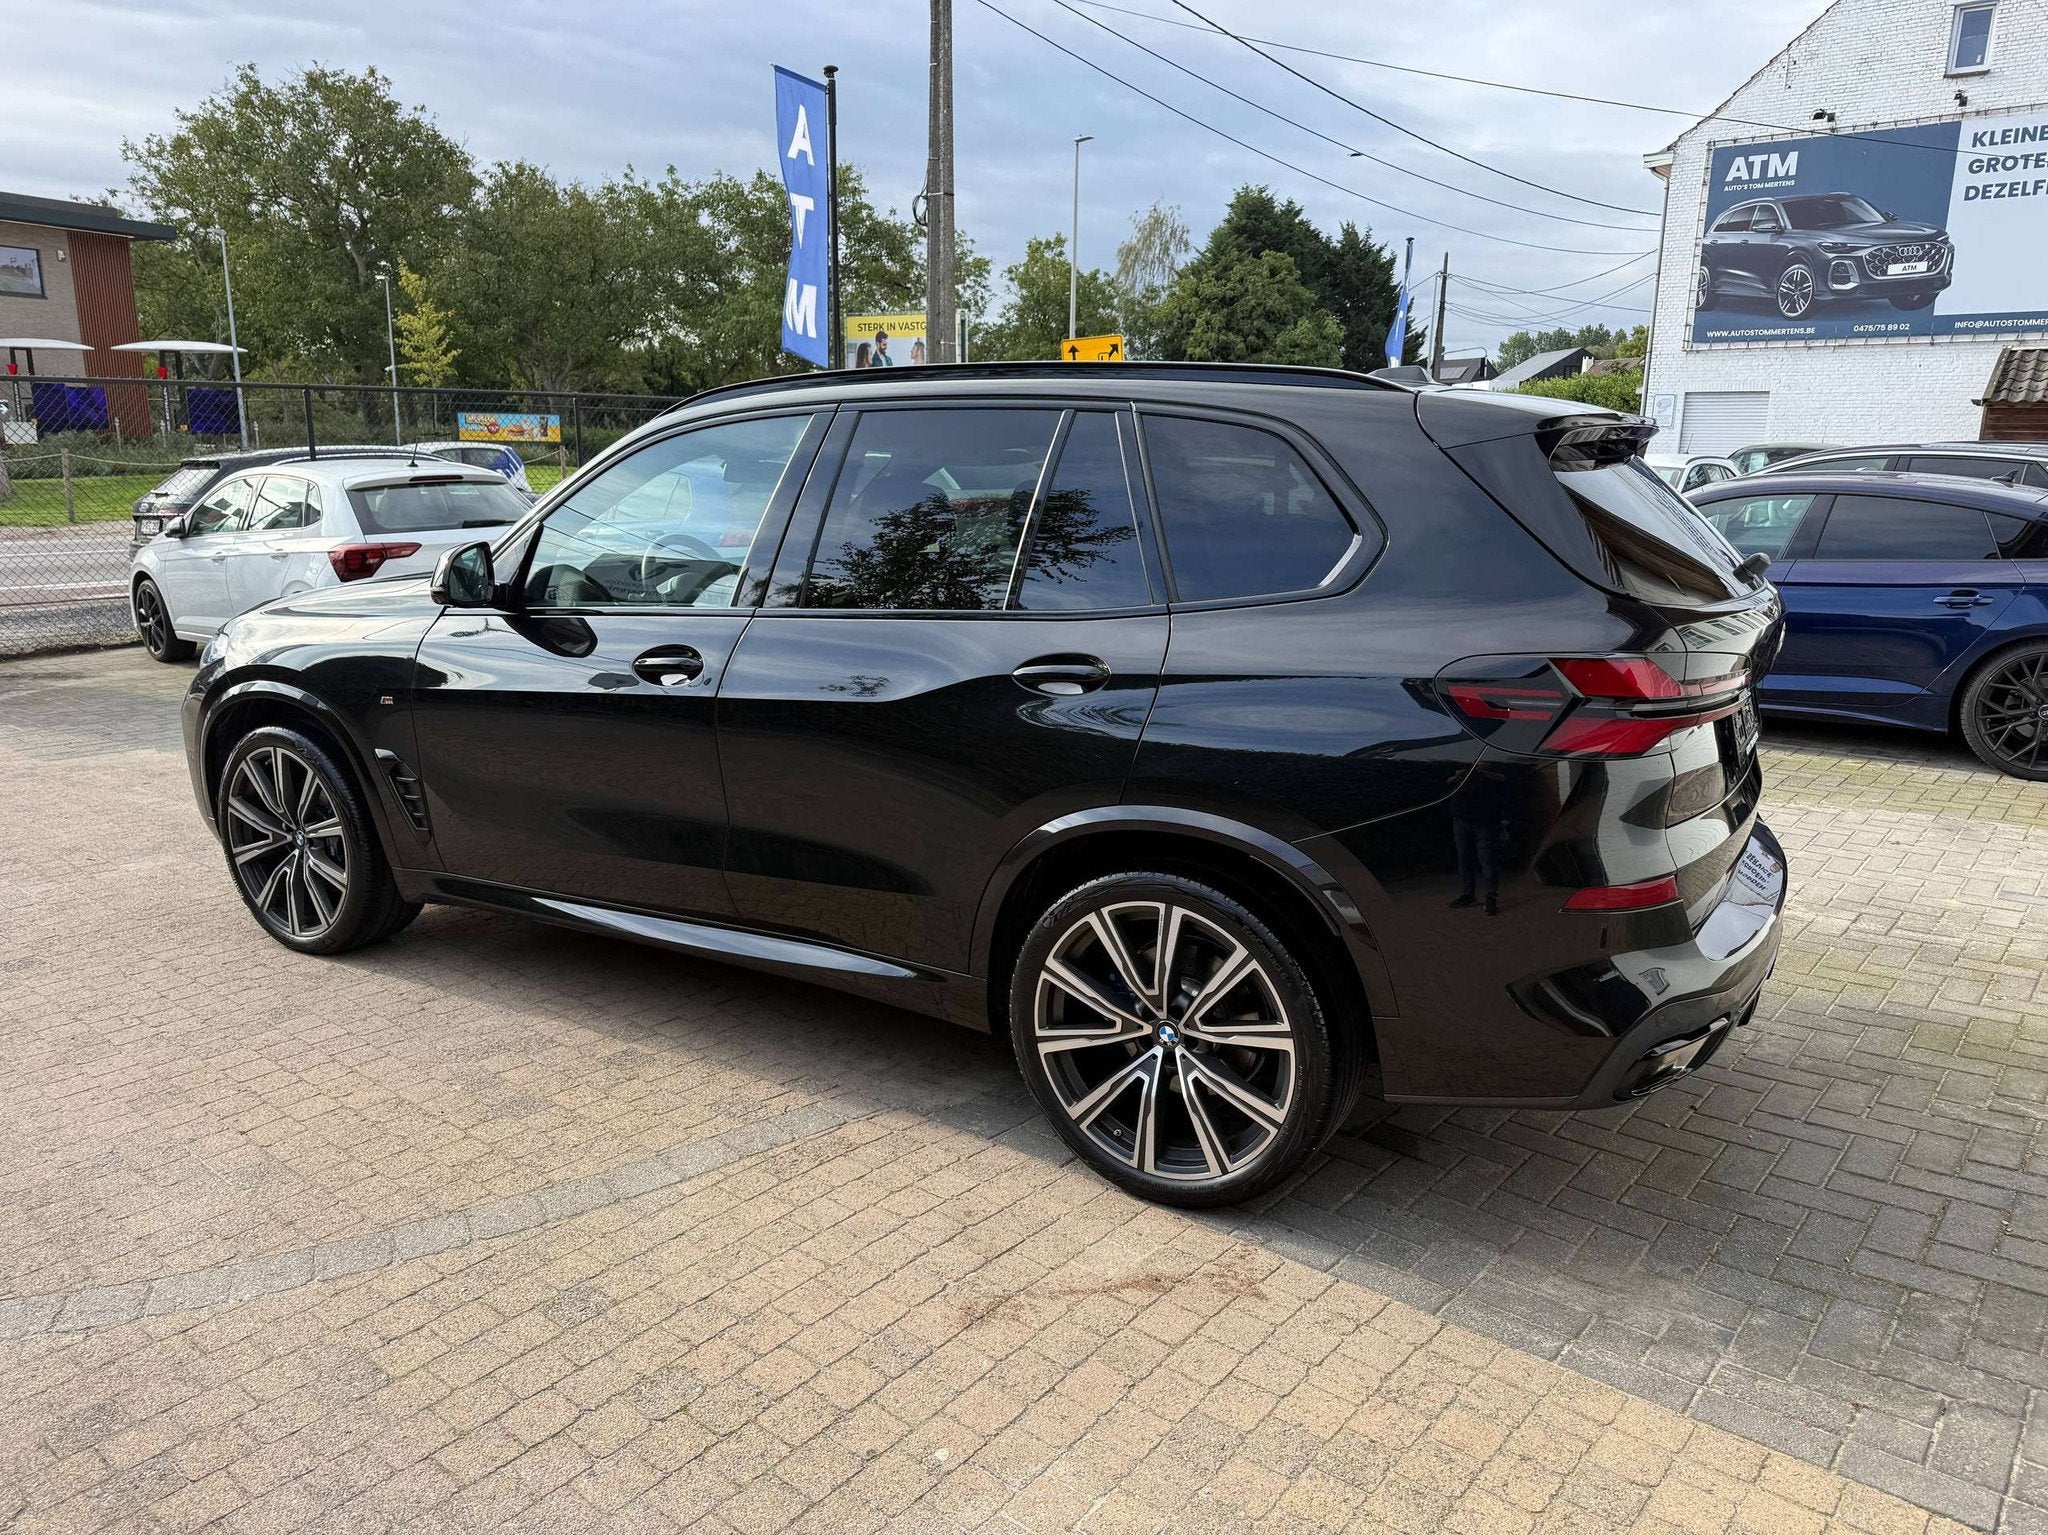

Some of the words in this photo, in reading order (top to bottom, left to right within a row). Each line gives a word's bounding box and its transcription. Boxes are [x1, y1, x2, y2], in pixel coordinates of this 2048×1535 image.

[1725, 151, 1799, 181] ATM
[1968, 152, 2048, 174] GROTE
[1764, 180, 1795, 188] MERTENS
[1964, 179, 2048, 201] DEZELF
[785, 103, 817, 338] ATM
[857, 323, 885, 332] STERK
[886, 322, 896, 331] IN
[1707, 327, 1816, 338] WWW.AUTOSTOMMERTENS.BE
[1899, 323, 1910, 331] 02
